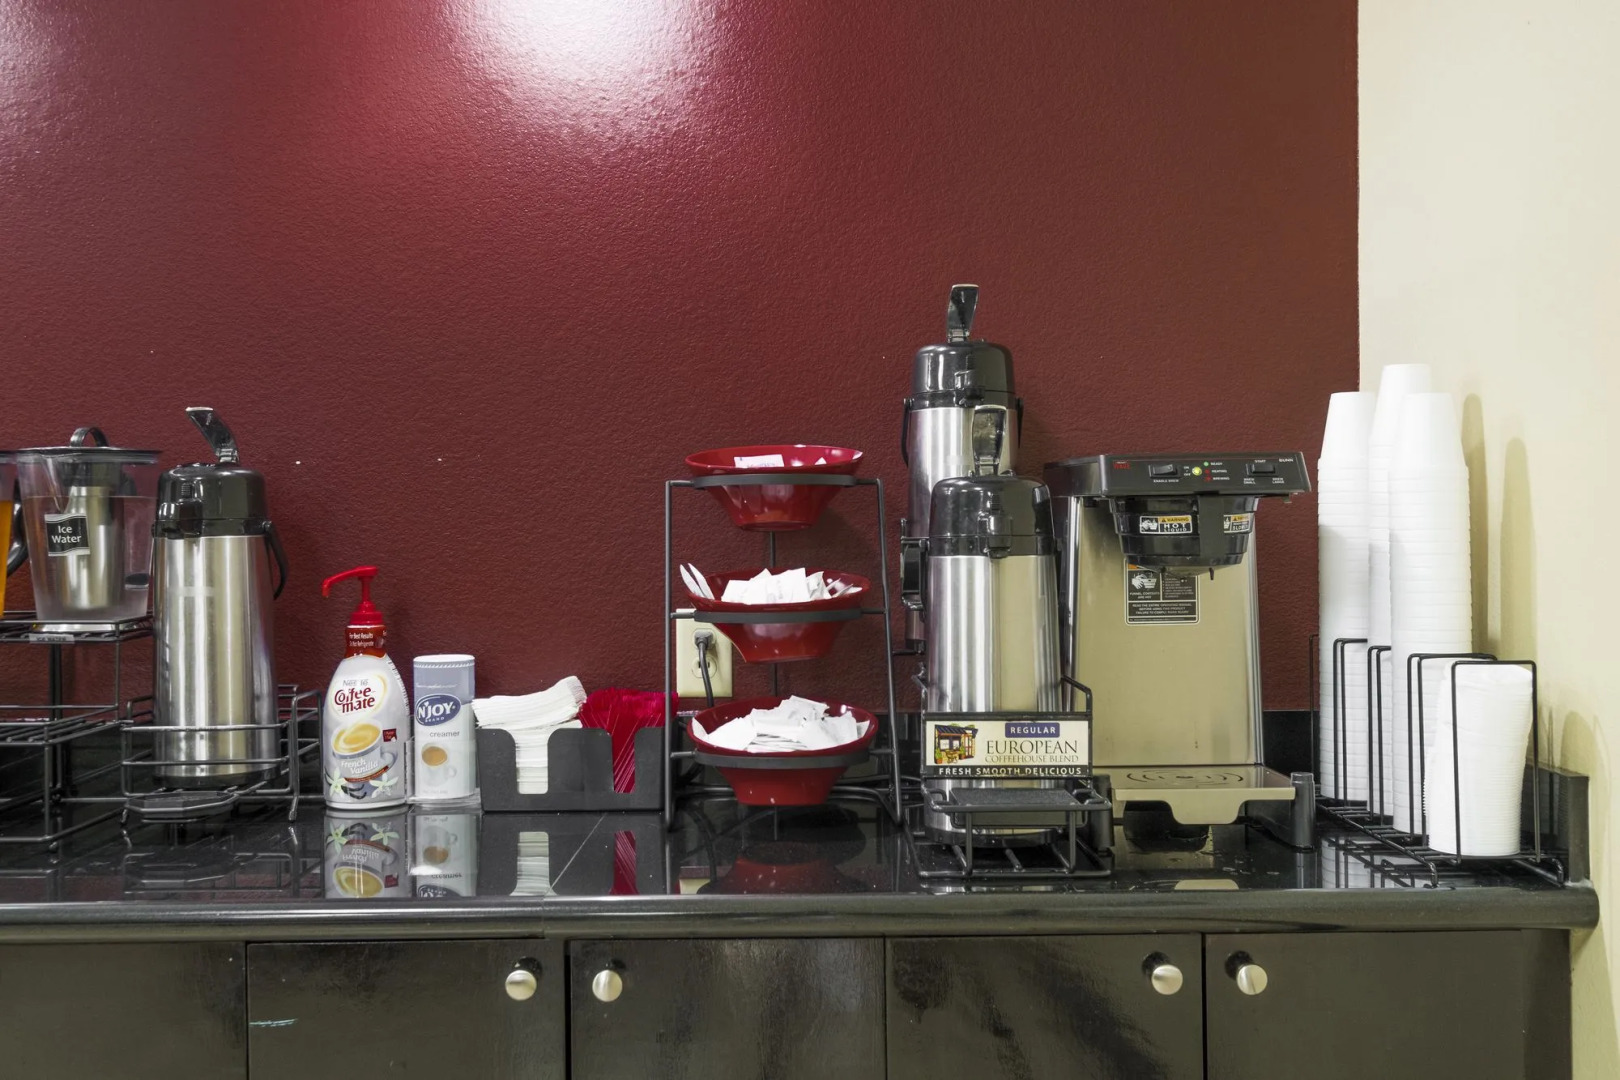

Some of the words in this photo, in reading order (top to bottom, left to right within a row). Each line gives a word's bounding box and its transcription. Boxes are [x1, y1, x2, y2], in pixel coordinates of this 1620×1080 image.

[58, 526, 72, 534] Ice
[52, 535, 82, 543] Water
[342, 697, 375, 713] mate
[986, 740, 1078, 754] EUROPEAN
[341, 758, 366, 768] French
[350, 761, 379, 774] Vanilla
